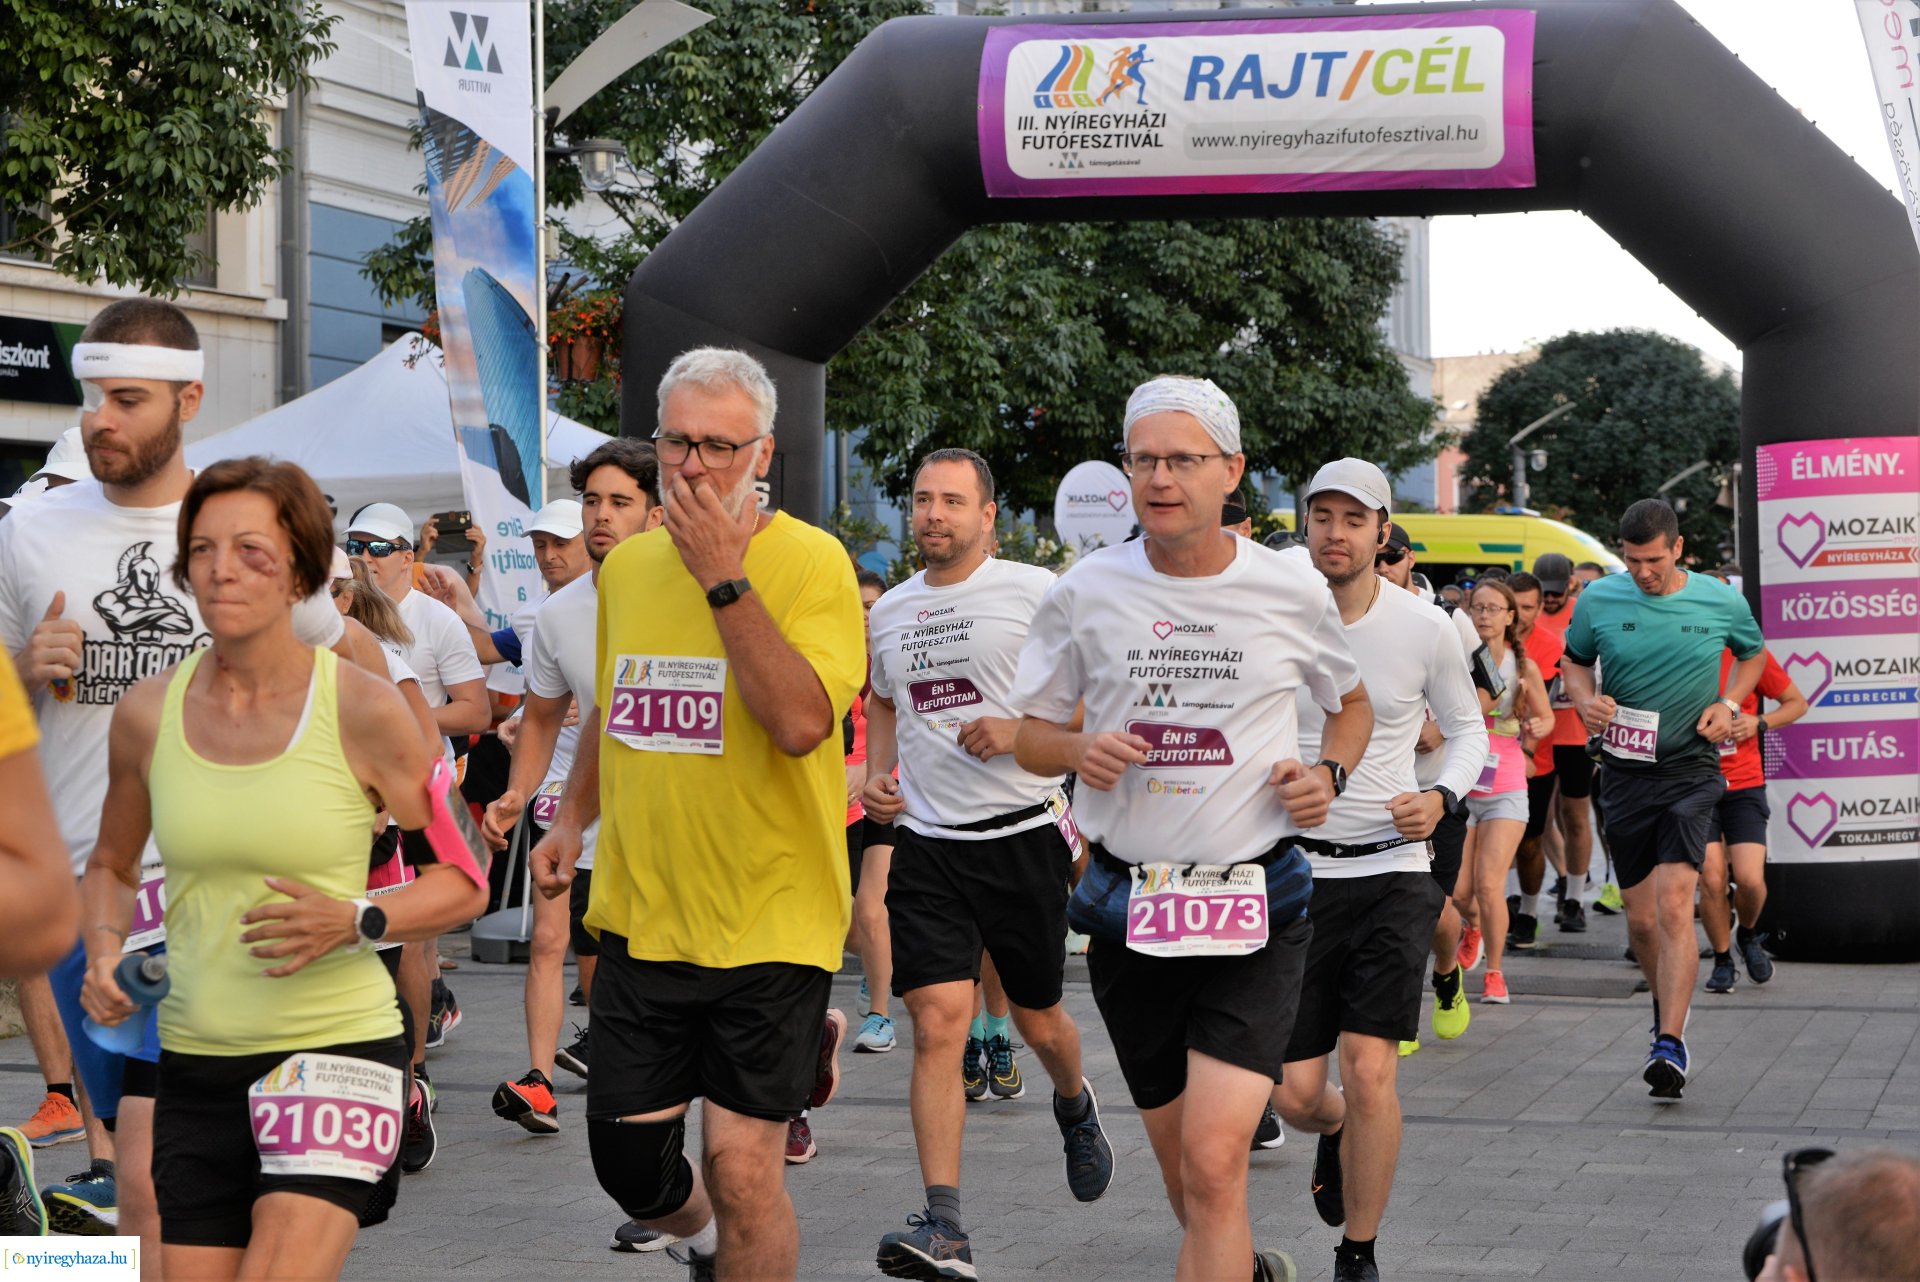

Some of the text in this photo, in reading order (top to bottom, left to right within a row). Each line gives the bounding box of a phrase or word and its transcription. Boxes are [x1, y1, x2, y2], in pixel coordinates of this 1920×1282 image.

[1184, 36, 1485, 101] RAJT/CÉL
[1017, 109, 1167, 131] III. NYÍREGYHÁZI
[1021, 130, 1164, 150] FUTÓFESZTIVÁL
[1192, 125, 1478, 151] www.nyiregyhazifutofesztival.hu
[1791, 448, 1905, 481] ÉLMÉNY.
[1827, 516, 1916, 538] MOZAIK
[1826, 551, 1906, 564] NYÍREGYHÁZA
[929, 605, 956, 618] MOZAIK
[913, 620, 975, 639] NYÍREGYHÁZI
[1173, 624, 1216, 633] MOZAIK
[901, 632, 970, 653] FUTÓFESZTIVÁL
[1127, 646, 1243, 663] III. NYÍREGYHÁZI
[658, 670, 717, 681] FUTÓFESZTIVÁL
[1129, 664, 1240, 680] FUTÓFESZTIVÁL
[931, 682, 956, 696] ÉN IS
[1833, 691, 1908, 704] DEBRECEN
[917, 691, 976, 711] LEFUTOTTAM
[612, 692, 719, 730] 21109
[1161, 730, 1197, 745] ÉN IS
[1811, 731, 1905, 762] FUTÁS.
[1145, 748, 1226, 762] EFUTOTTAM
[1838, 831, 1915, 844] TOKAJI-HEGY
[1132, 897, 1263, 936] 21073
[254, 1101, 397, 1156] 21030
